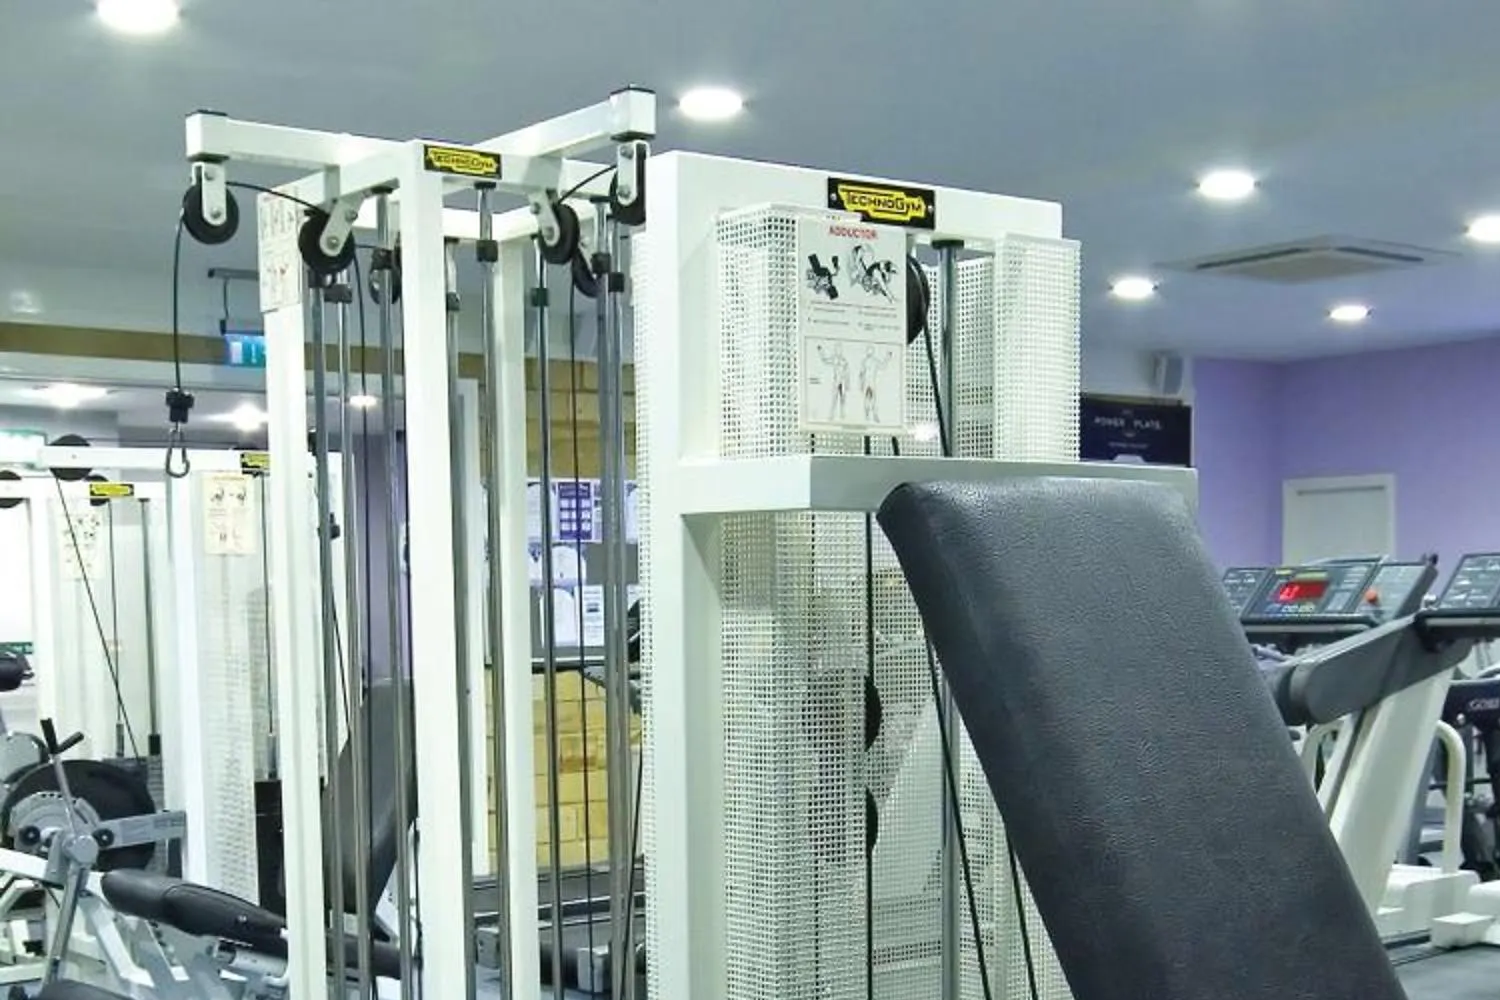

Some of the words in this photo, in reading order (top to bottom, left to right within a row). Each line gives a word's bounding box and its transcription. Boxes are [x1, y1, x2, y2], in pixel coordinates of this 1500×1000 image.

[829, 226, 877, 239] ADDUCTOR
[1094, 416, 1125, 427] POWER
[1132, 420, 1162, 431] PLATE
